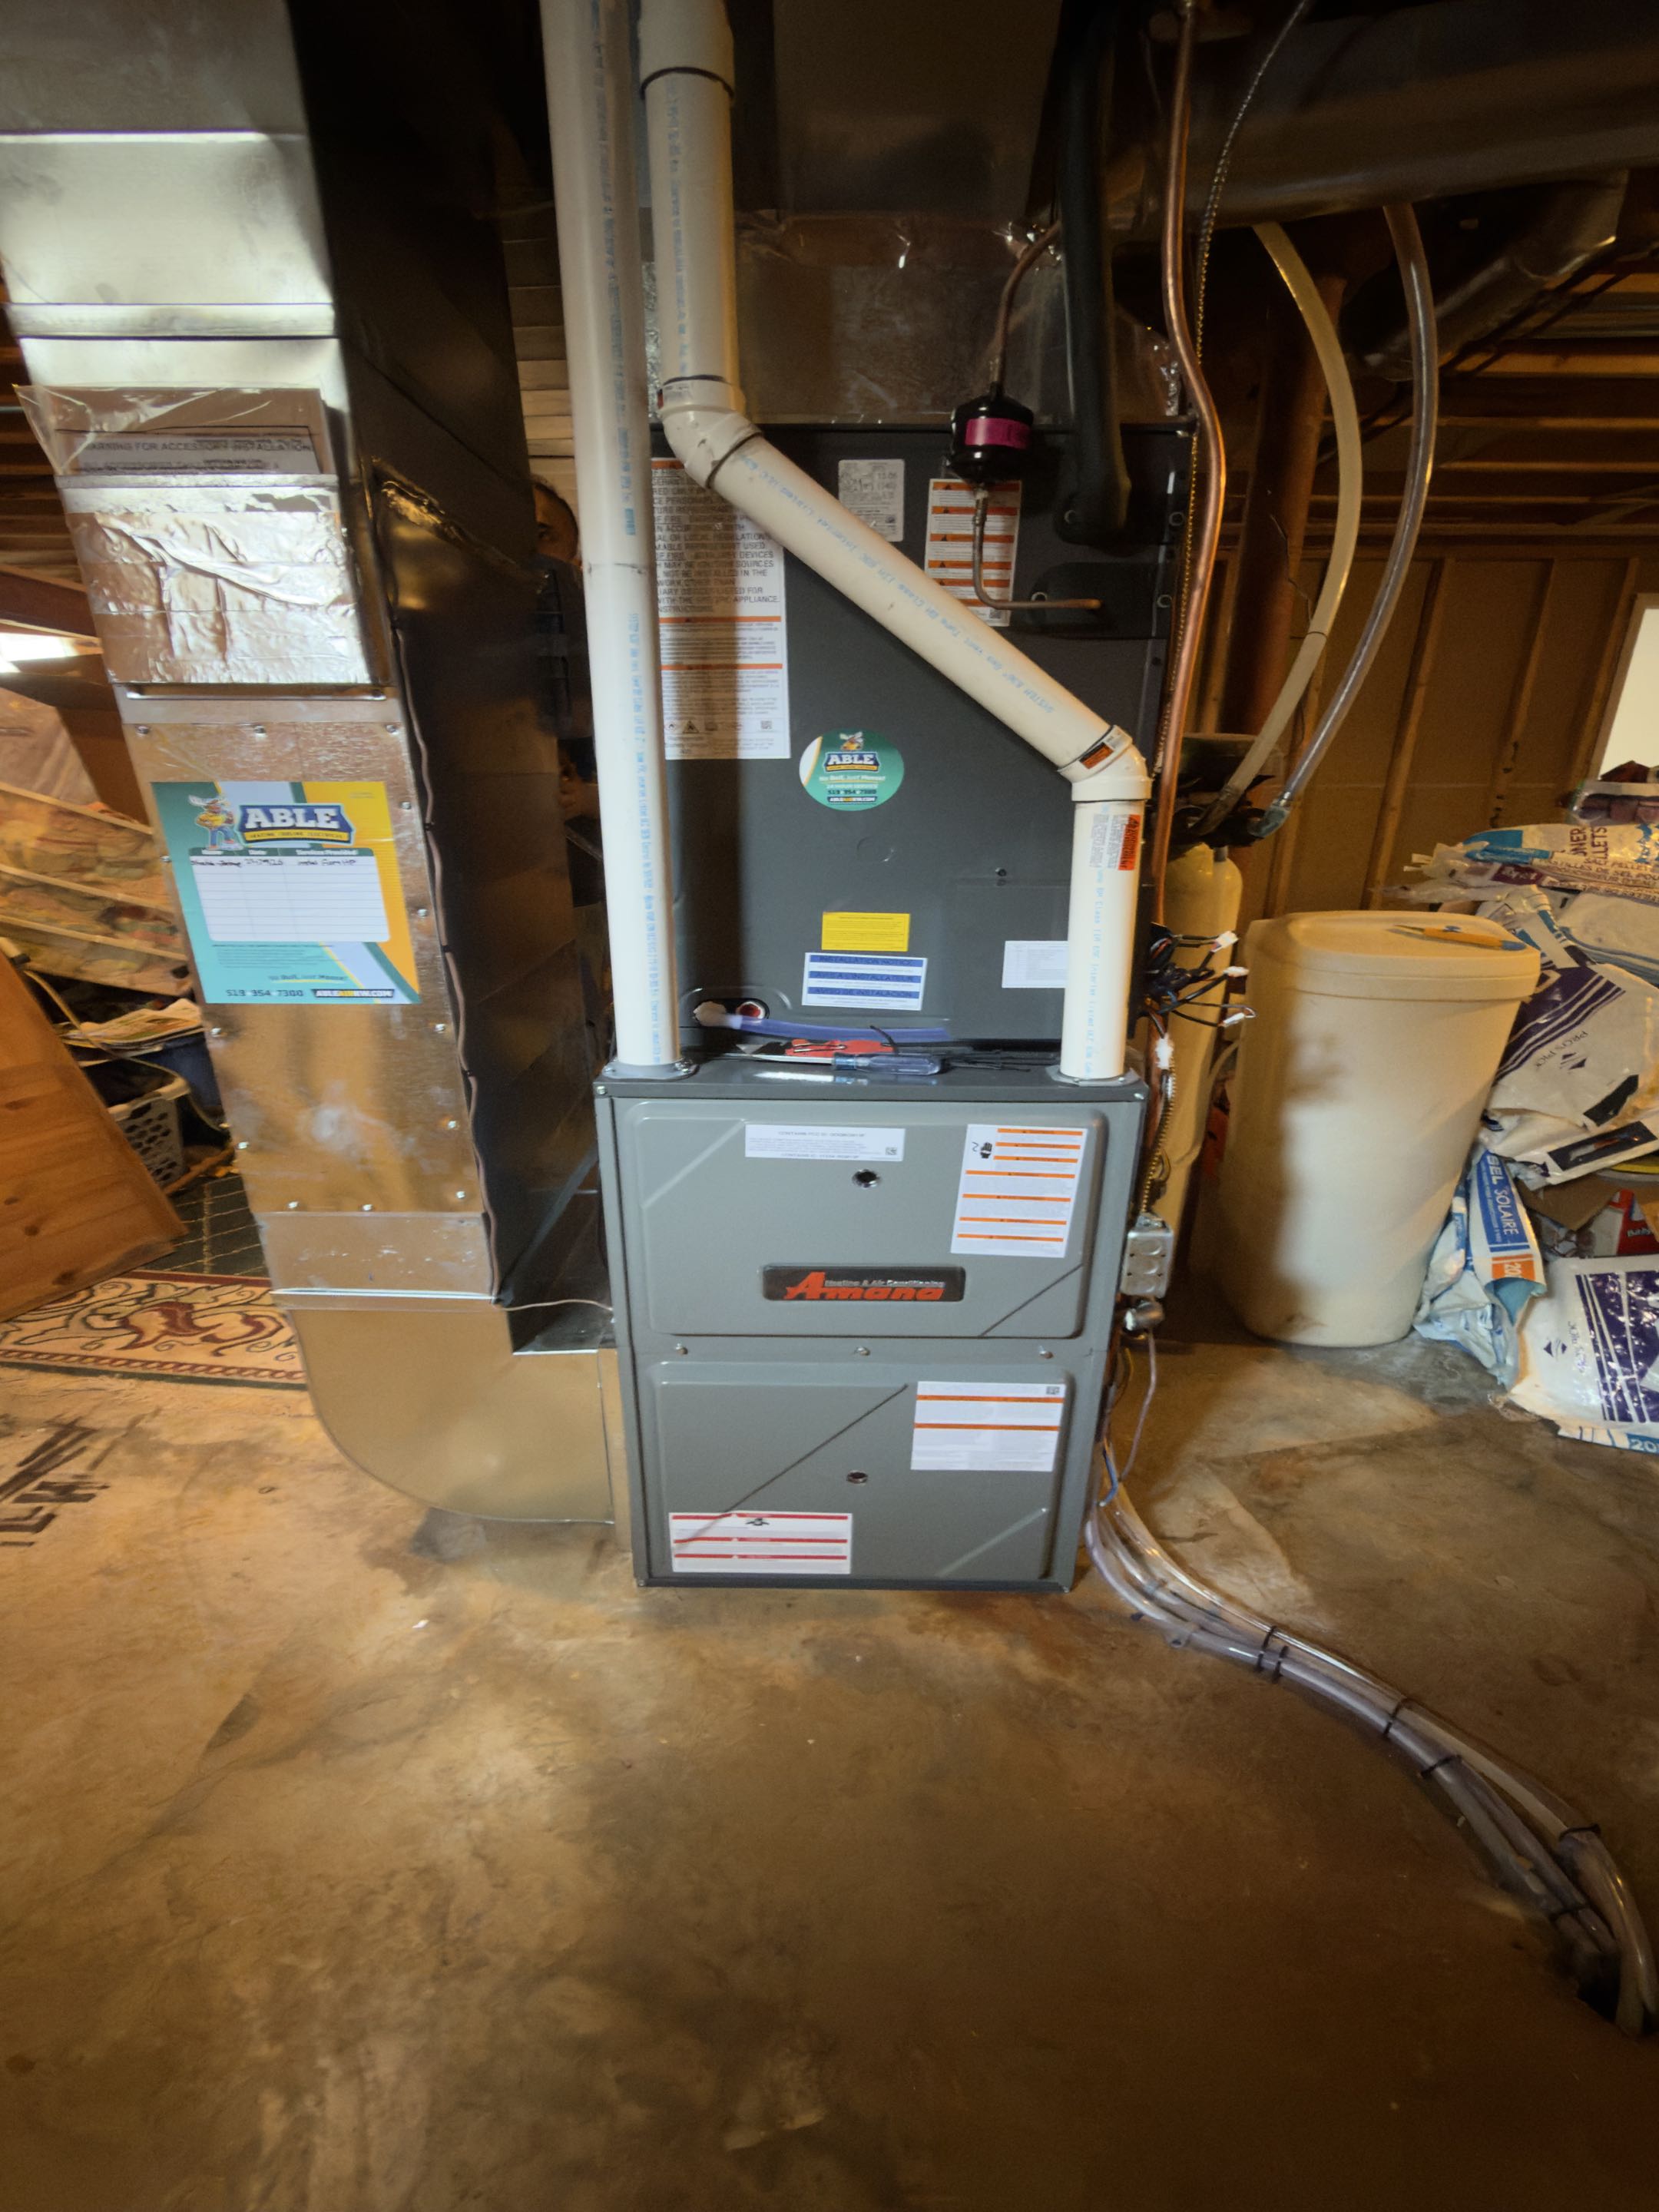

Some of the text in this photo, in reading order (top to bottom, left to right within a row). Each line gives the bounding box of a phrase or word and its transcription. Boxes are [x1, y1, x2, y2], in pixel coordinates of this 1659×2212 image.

[85, 442, 131, 451] ARNING
[739, 551, 774, 559] DEVICES
[828, 754, 875, 765] ABLE
[246, 808, 340, 830] ABLE
[1485, 1154, 1501, 1184] SEL
[1495, 1187, 1519, 1237] SOLAIRE
[783, 1271, 945, 1300] Amana
